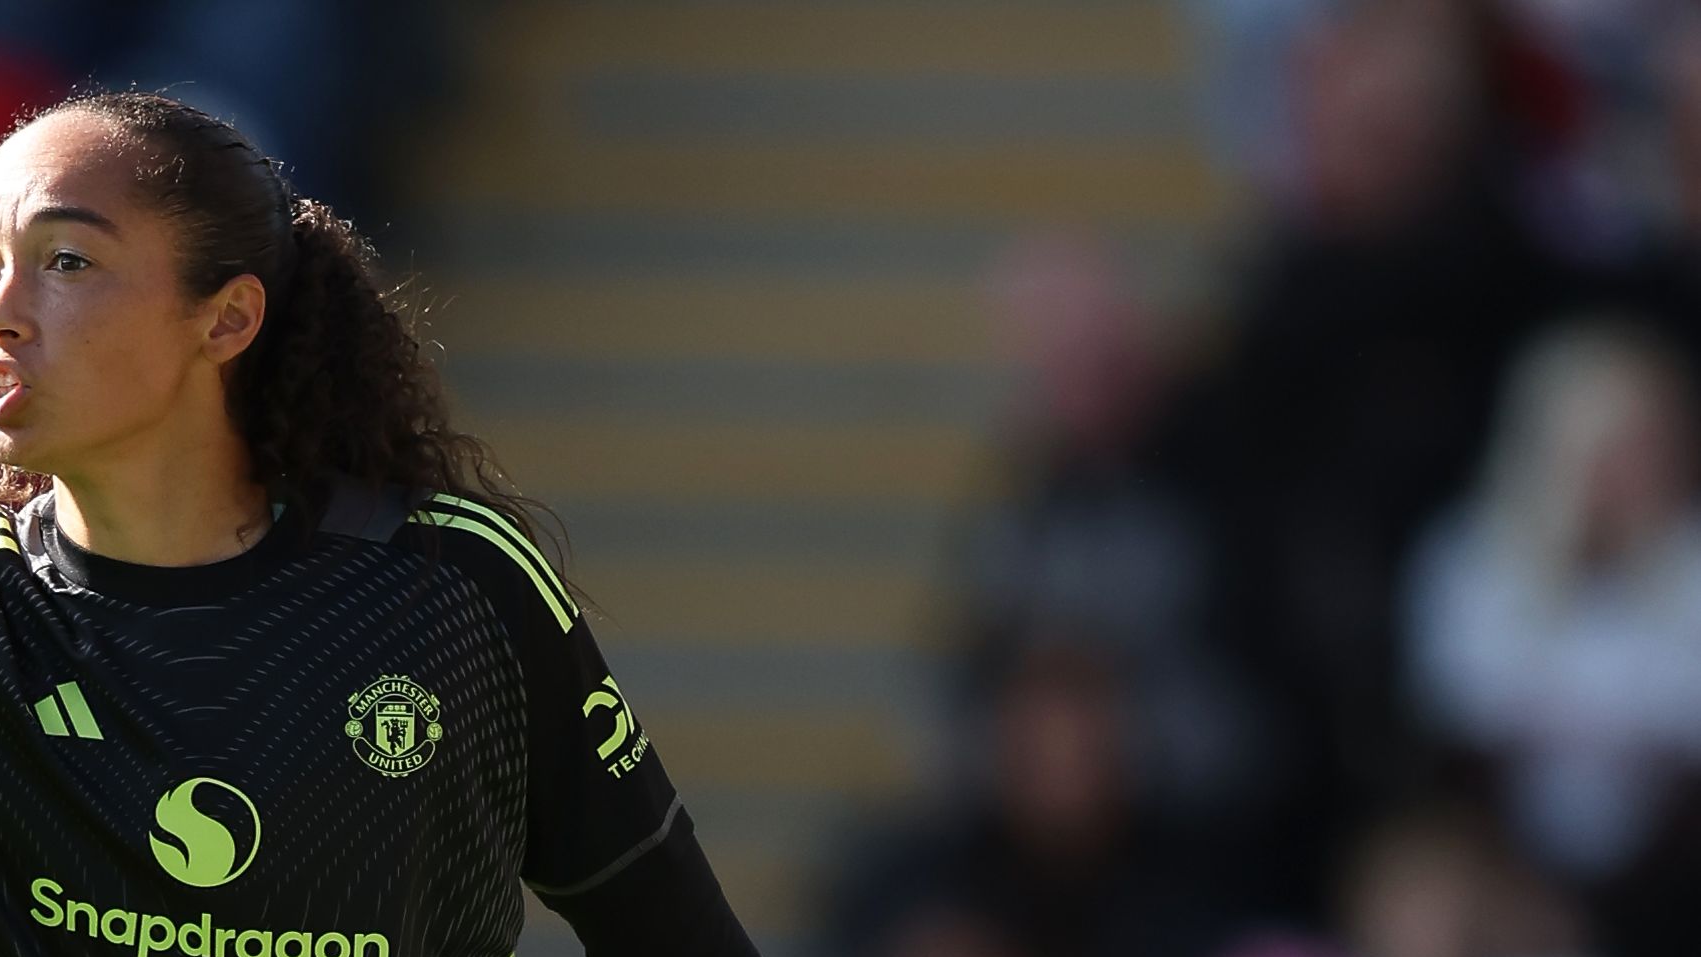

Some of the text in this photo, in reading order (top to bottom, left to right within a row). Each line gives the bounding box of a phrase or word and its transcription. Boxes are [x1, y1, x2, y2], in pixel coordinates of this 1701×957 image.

[355, 682, 434, 716] MANCHESTER
[368, 752, 423, 770] UNITED
[607, 729, 650, 779] TECHN
